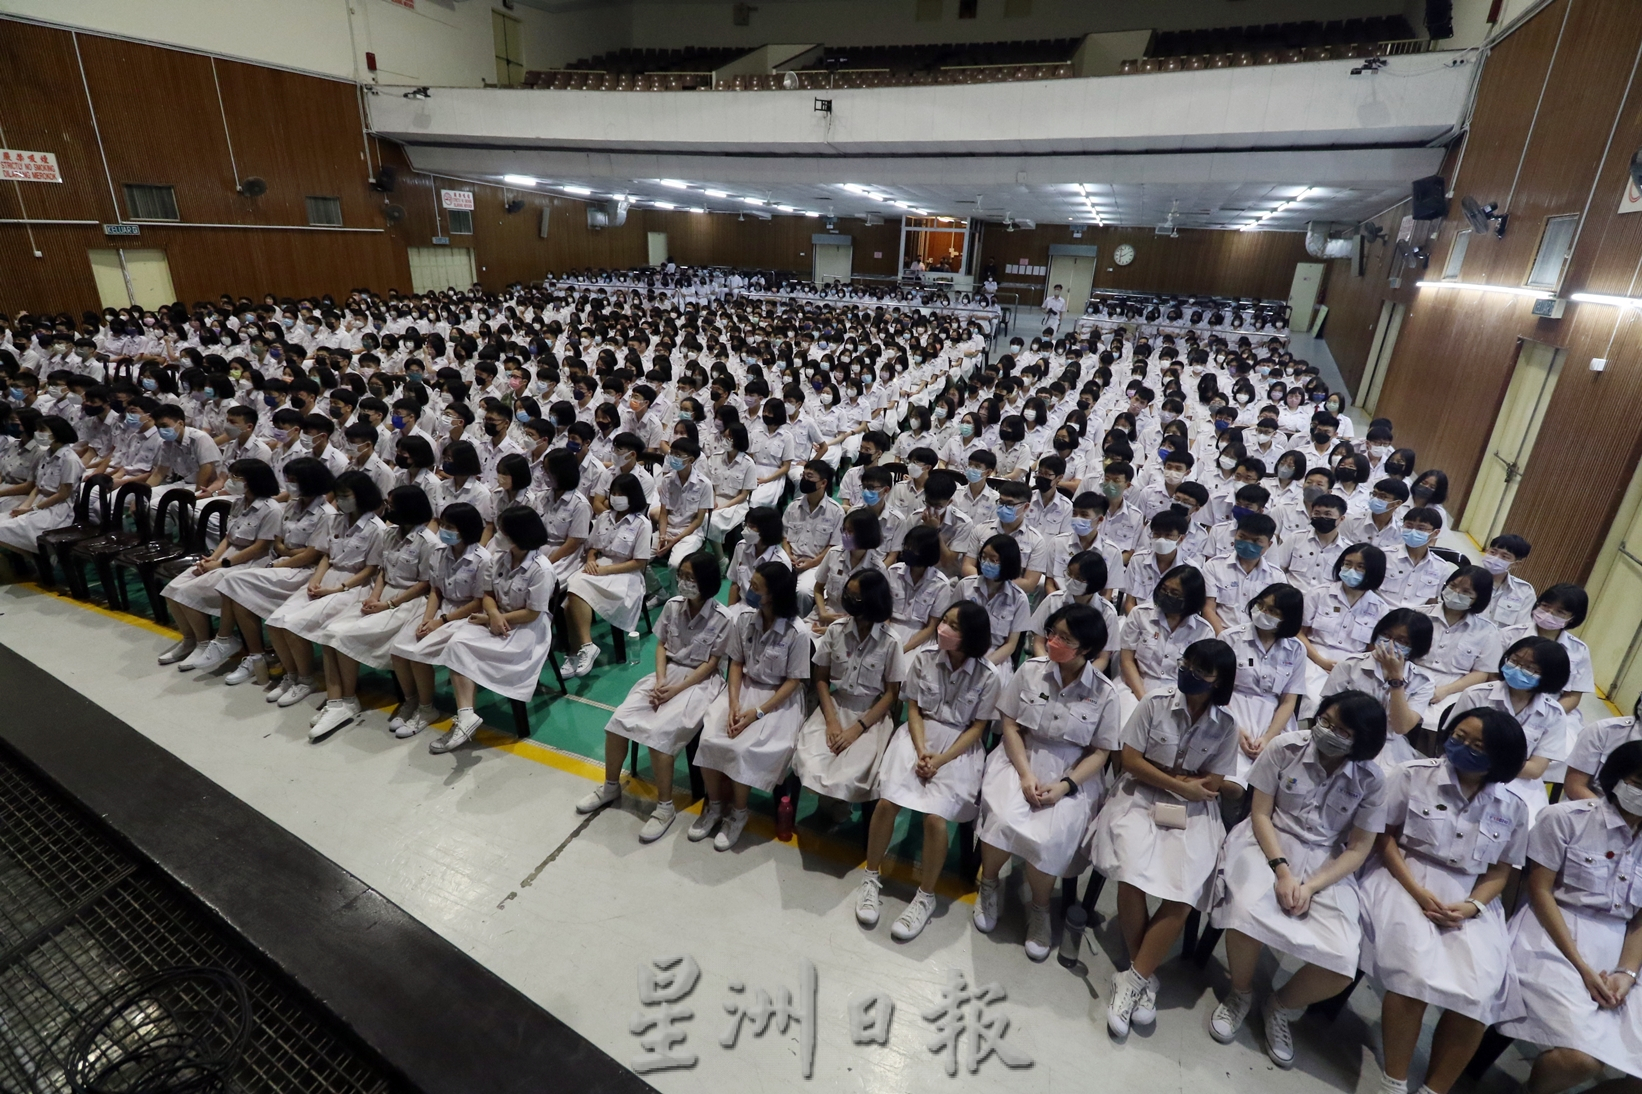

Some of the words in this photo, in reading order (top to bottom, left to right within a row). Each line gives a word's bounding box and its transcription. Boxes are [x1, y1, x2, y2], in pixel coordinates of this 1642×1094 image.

[1, 161, 23, 170] STRICTLY
[24, 163, 32, 171] NO
[33, 164, 56, 172] SMOKING
[106, 225, 133, 234] KELUAR
